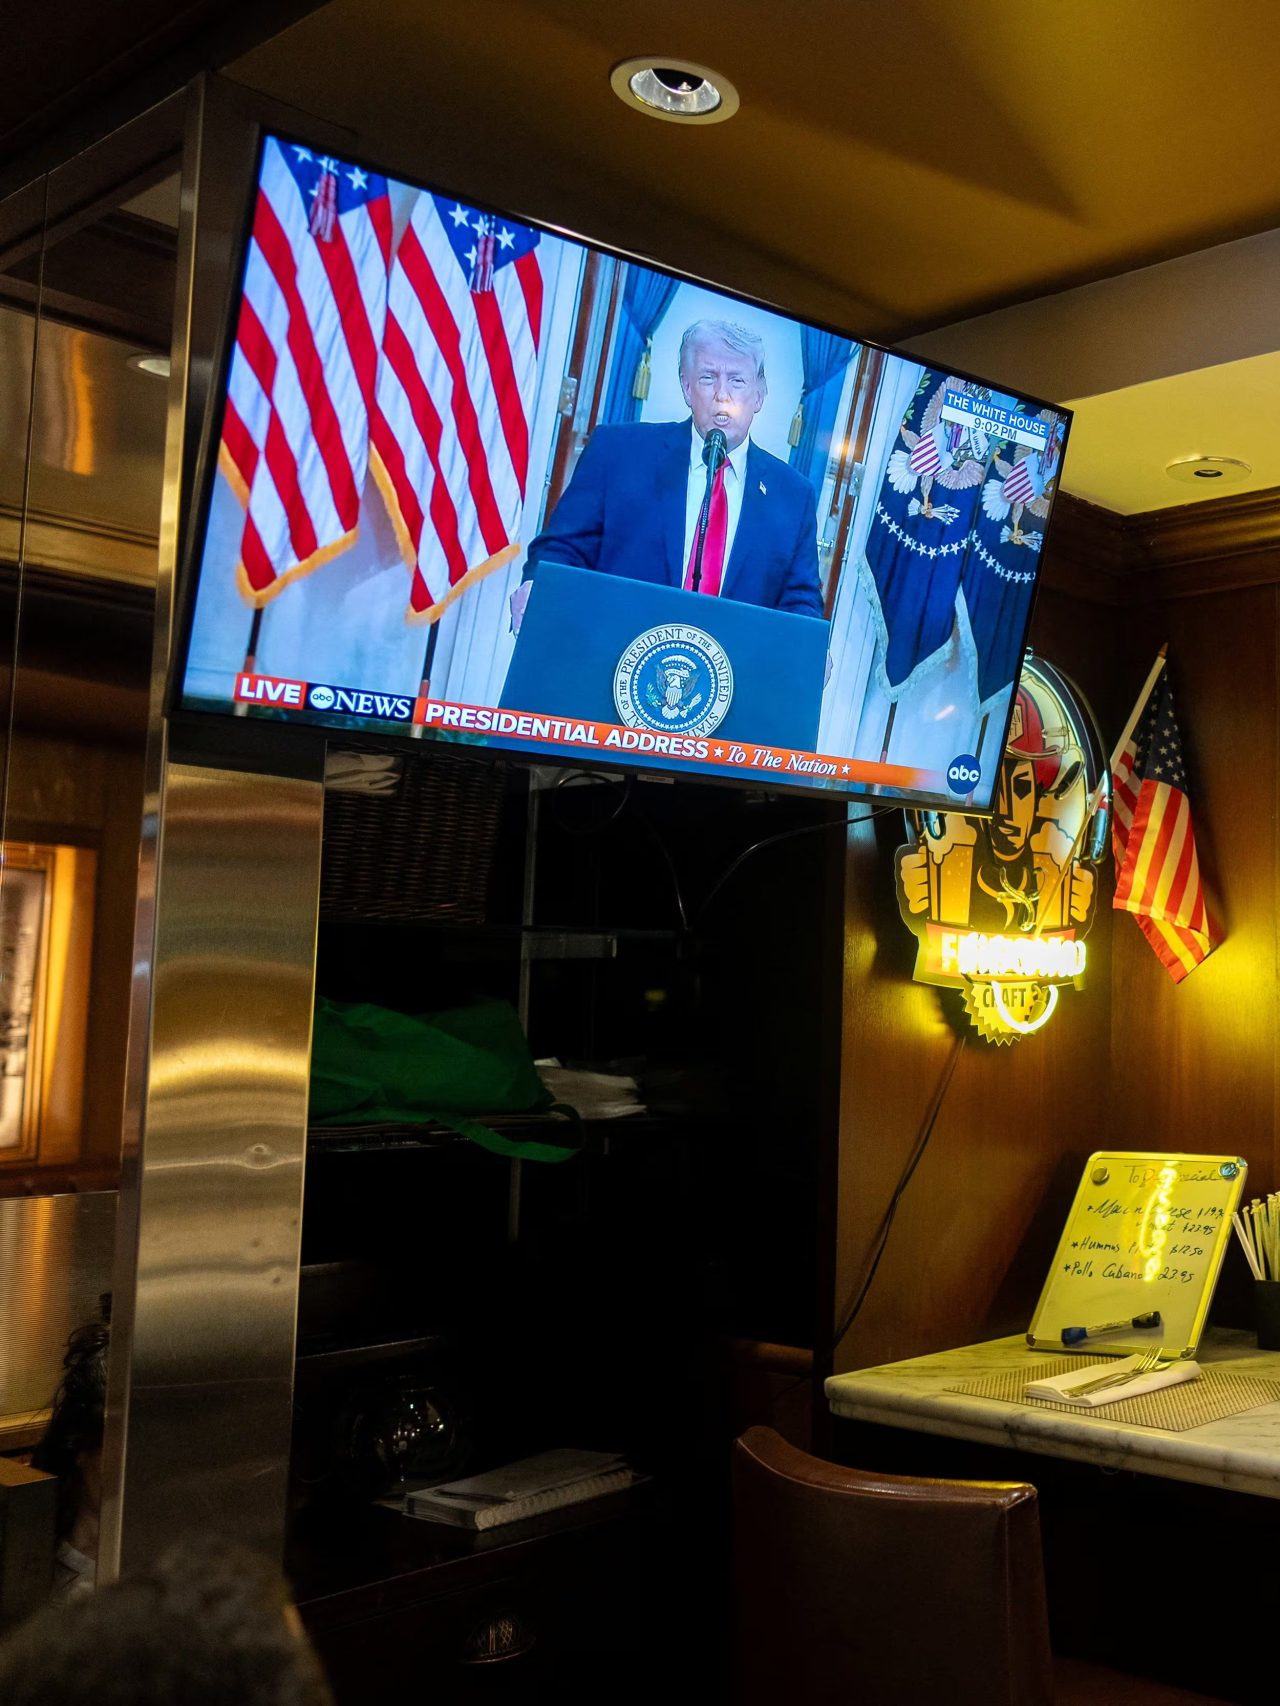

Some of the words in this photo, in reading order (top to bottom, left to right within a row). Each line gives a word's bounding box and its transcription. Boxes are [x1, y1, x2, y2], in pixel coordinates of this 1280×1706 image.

[948, 393, 969, 409] THE
[972, 401, 1006, 423] WHITE
[1009, 414, 1047, 436] HOUSE
[974, 418, 999, 435] 9:02
[1001, 427, 1018, 441] PM
[621, 628, 683, 675] PRESIDENT
[686, 631, 698, 641] OF
[697, 636, 712, 651] THE
[619, 679, 628, 697] THE
[711, 651, 730, 703] UNITED
[240, 678, 302, 704] LIVE
[334, 690, 411, 719] NEWS
[425, 703, 600, 745] PRESIDENTIAL
[604, 729, 709, 759] ADDRESS
[726, 744, 746, 764] To
[751, 748, 782, 768] The
[785, 754, 838, 776] Nation
[948, 764, 980, 782] abc
